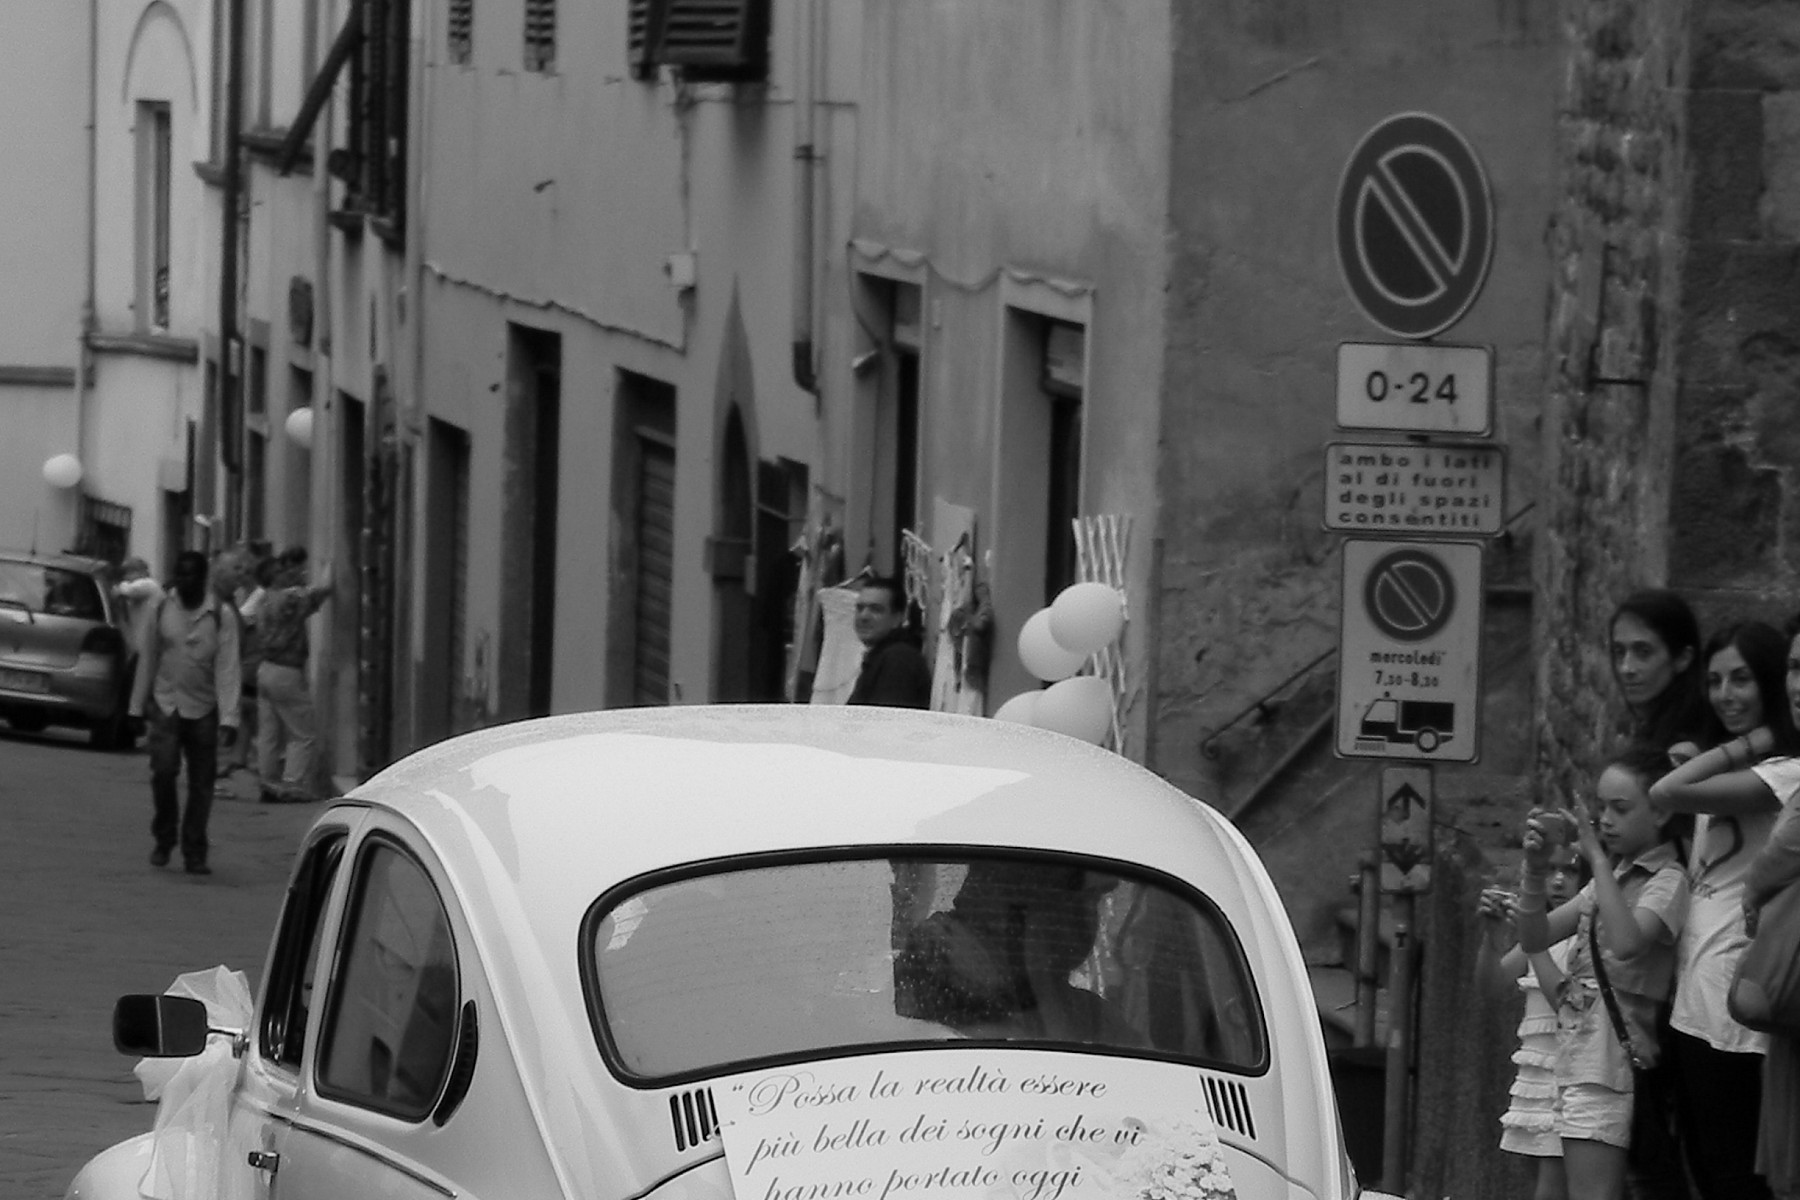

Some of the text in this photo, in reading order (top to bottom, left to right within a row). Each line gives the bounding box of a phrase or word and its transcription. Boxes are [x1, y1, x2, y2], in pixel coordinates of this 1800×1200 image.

[1366, 370, 1458, 405] 0-24
[1339, 453, 1490, 469] ambo i lati
[1339, 472, 1478, 488] al di fuori
[1339, 490, 1490, 509] degli spazi
[1338, 511, 1480, 526] consentiti
[869, 1070, 903, 1099] la
[915, 1065, 1010, 1097] realtà
[1020, 1074, 1107, 1098] essere
[744, 1114, 1144, 1176] più bella dei sogni che vi
